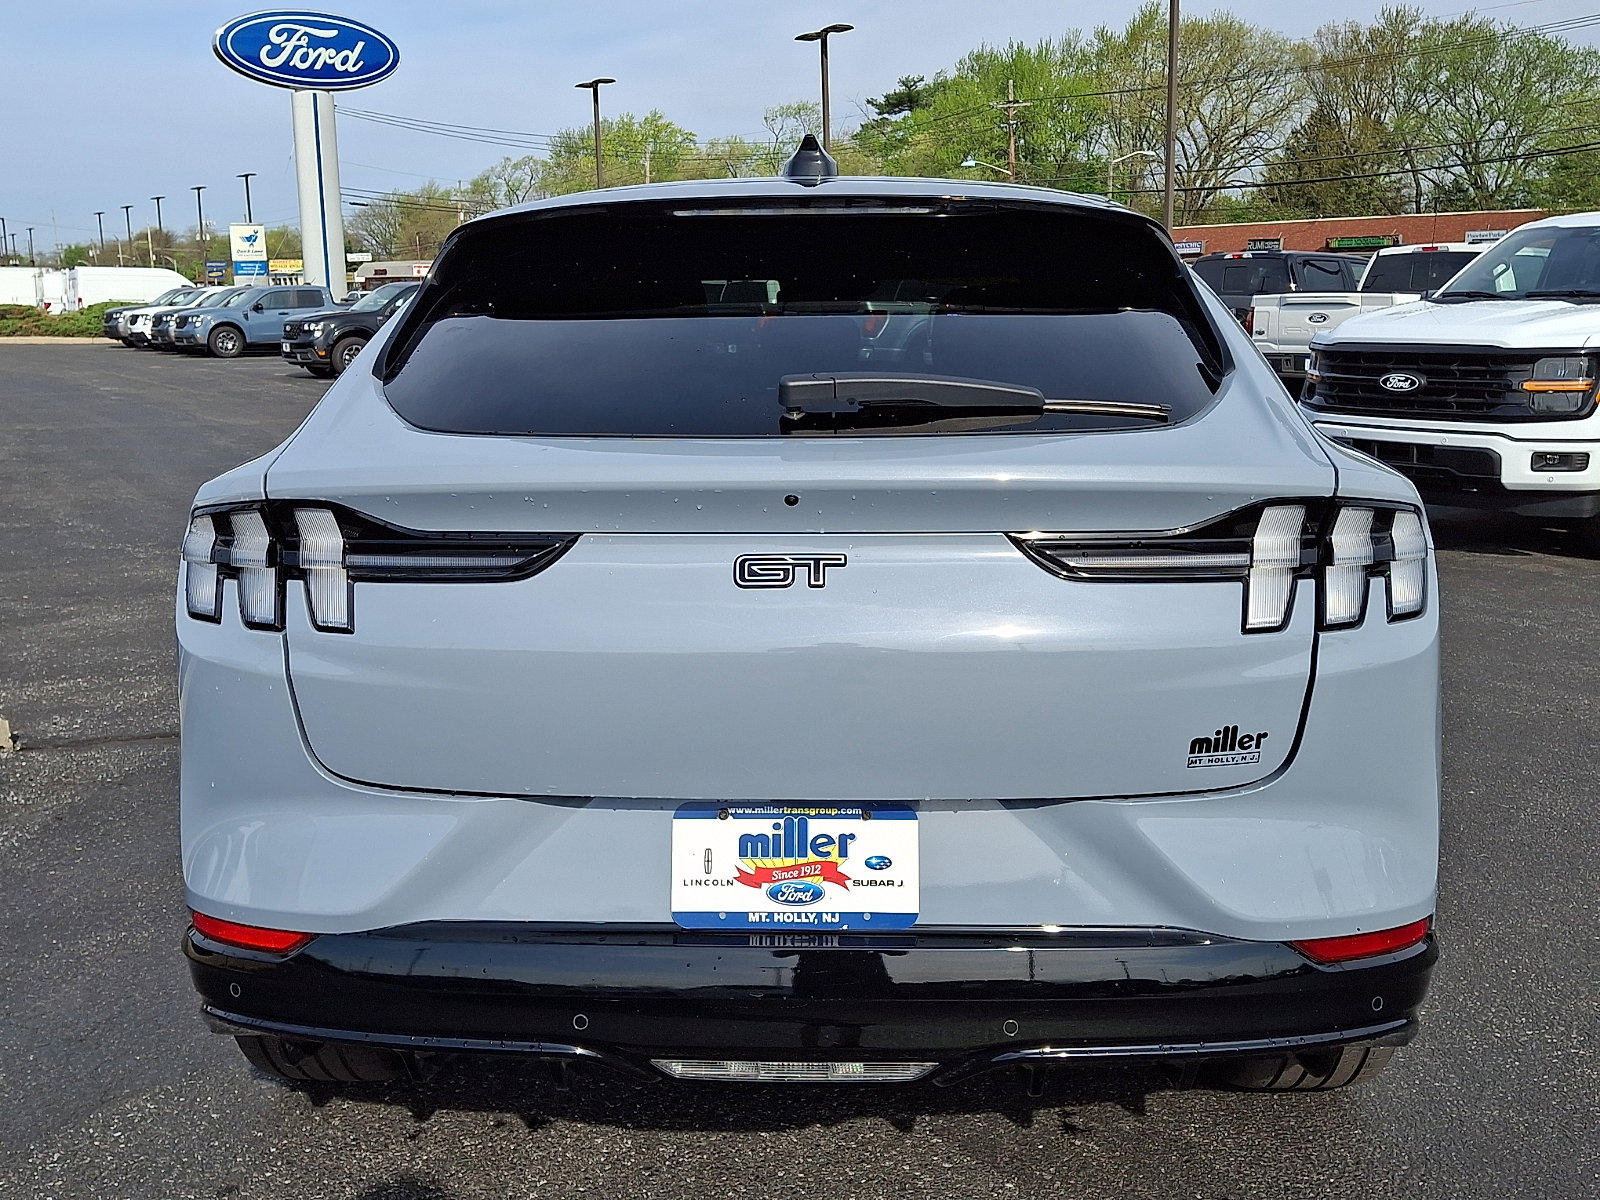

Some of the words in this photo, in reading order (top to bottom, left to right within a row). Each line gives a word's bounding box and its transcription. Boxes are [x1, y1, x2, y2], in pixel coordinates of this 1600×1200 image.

[260, 23, 366, 73] Ford
[1386, 376, 1411, 388] Ford
[733, 553, 848, 589] GT
[1188, 724, 1269, 755] miller
[728, 806, 863, 817] www.millertransgroup.com
[738, 816, 857, 859] miller
[771, 869, 799, 881] Since
[800, 864, 822, 877] 1912
[683, 878, 734, 887] LINCOLN
[777, 883, 814, 902] Ford
[748, 912, 770, 923] MT.
[773, 912, 818, 925] HOLLY,
[822, 912, 840, 923] NJ
